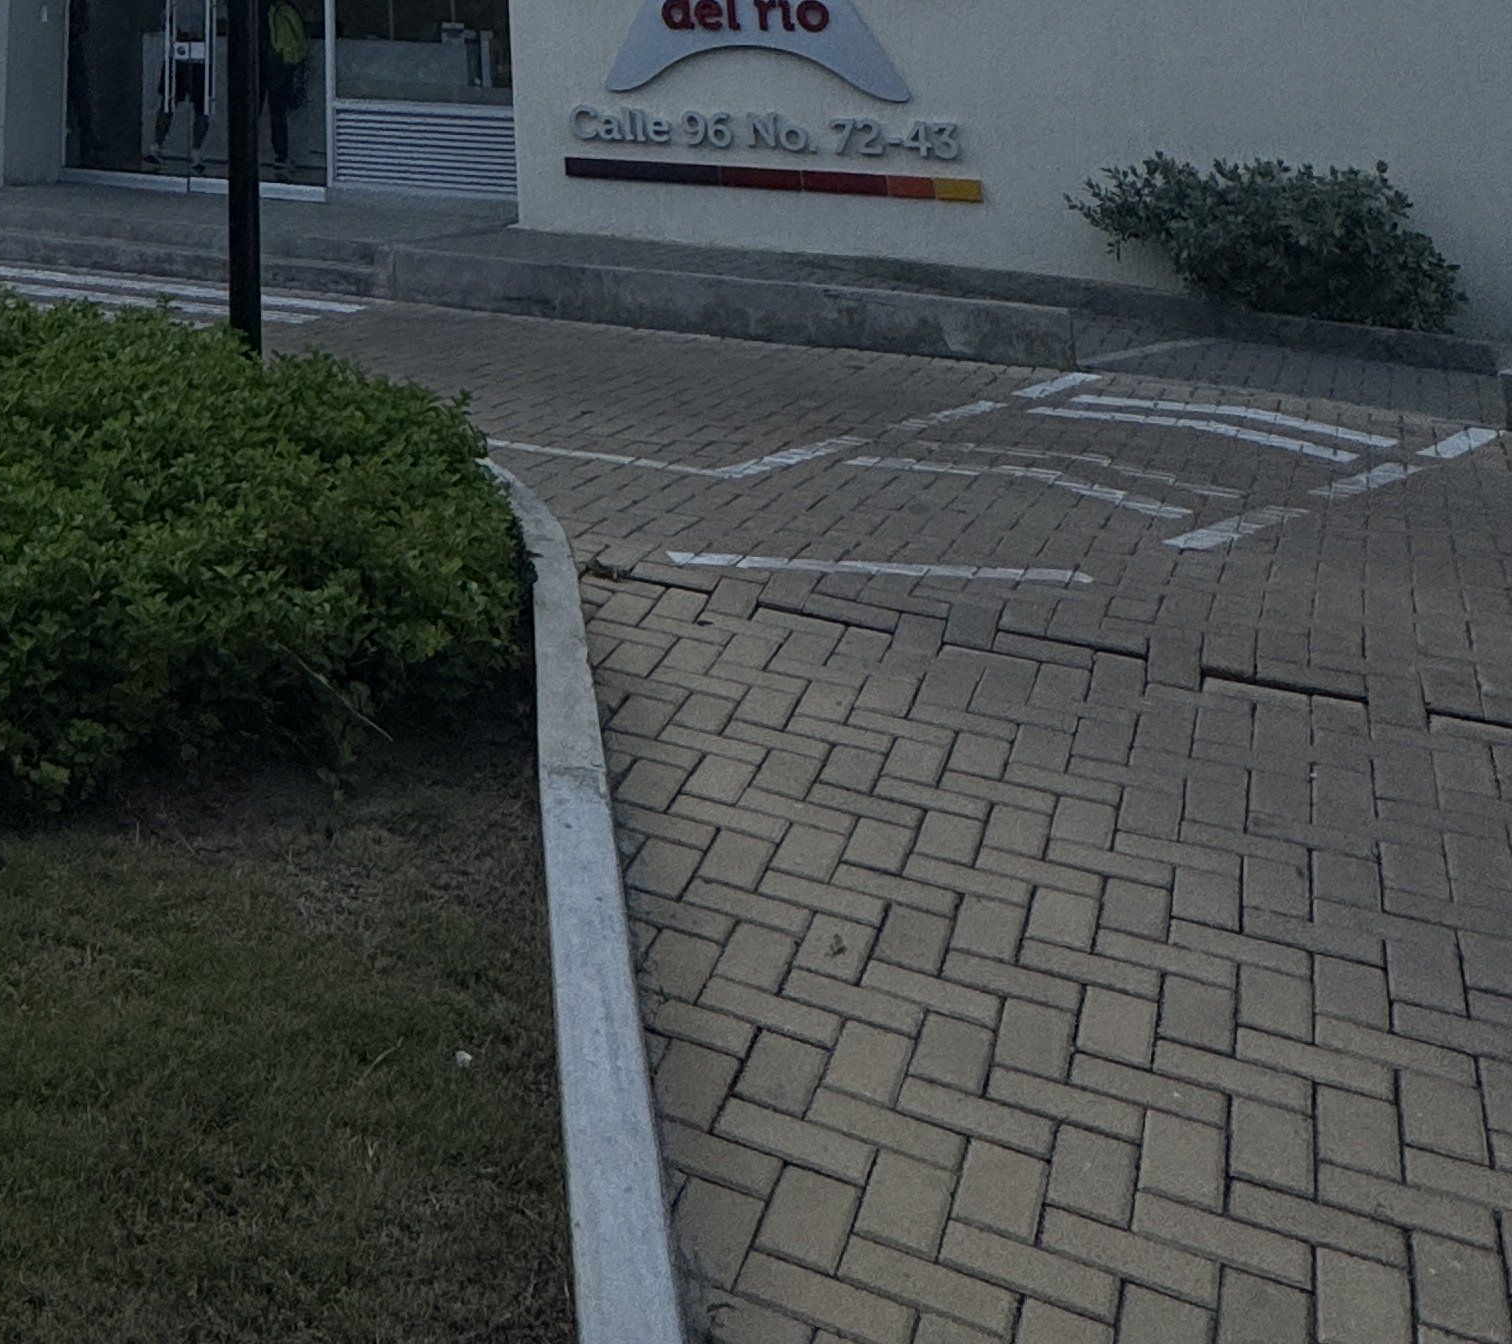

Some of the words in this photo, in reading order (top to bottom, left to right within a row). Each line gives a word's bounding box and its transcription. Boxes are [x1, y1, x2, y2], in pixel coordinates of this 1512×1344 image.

[569, 104, 672, 146] Calle
[682, 111, 734, 150] 96
[747, 113, 818, 153] No.
[829, 118, 961, 161] 72-43
